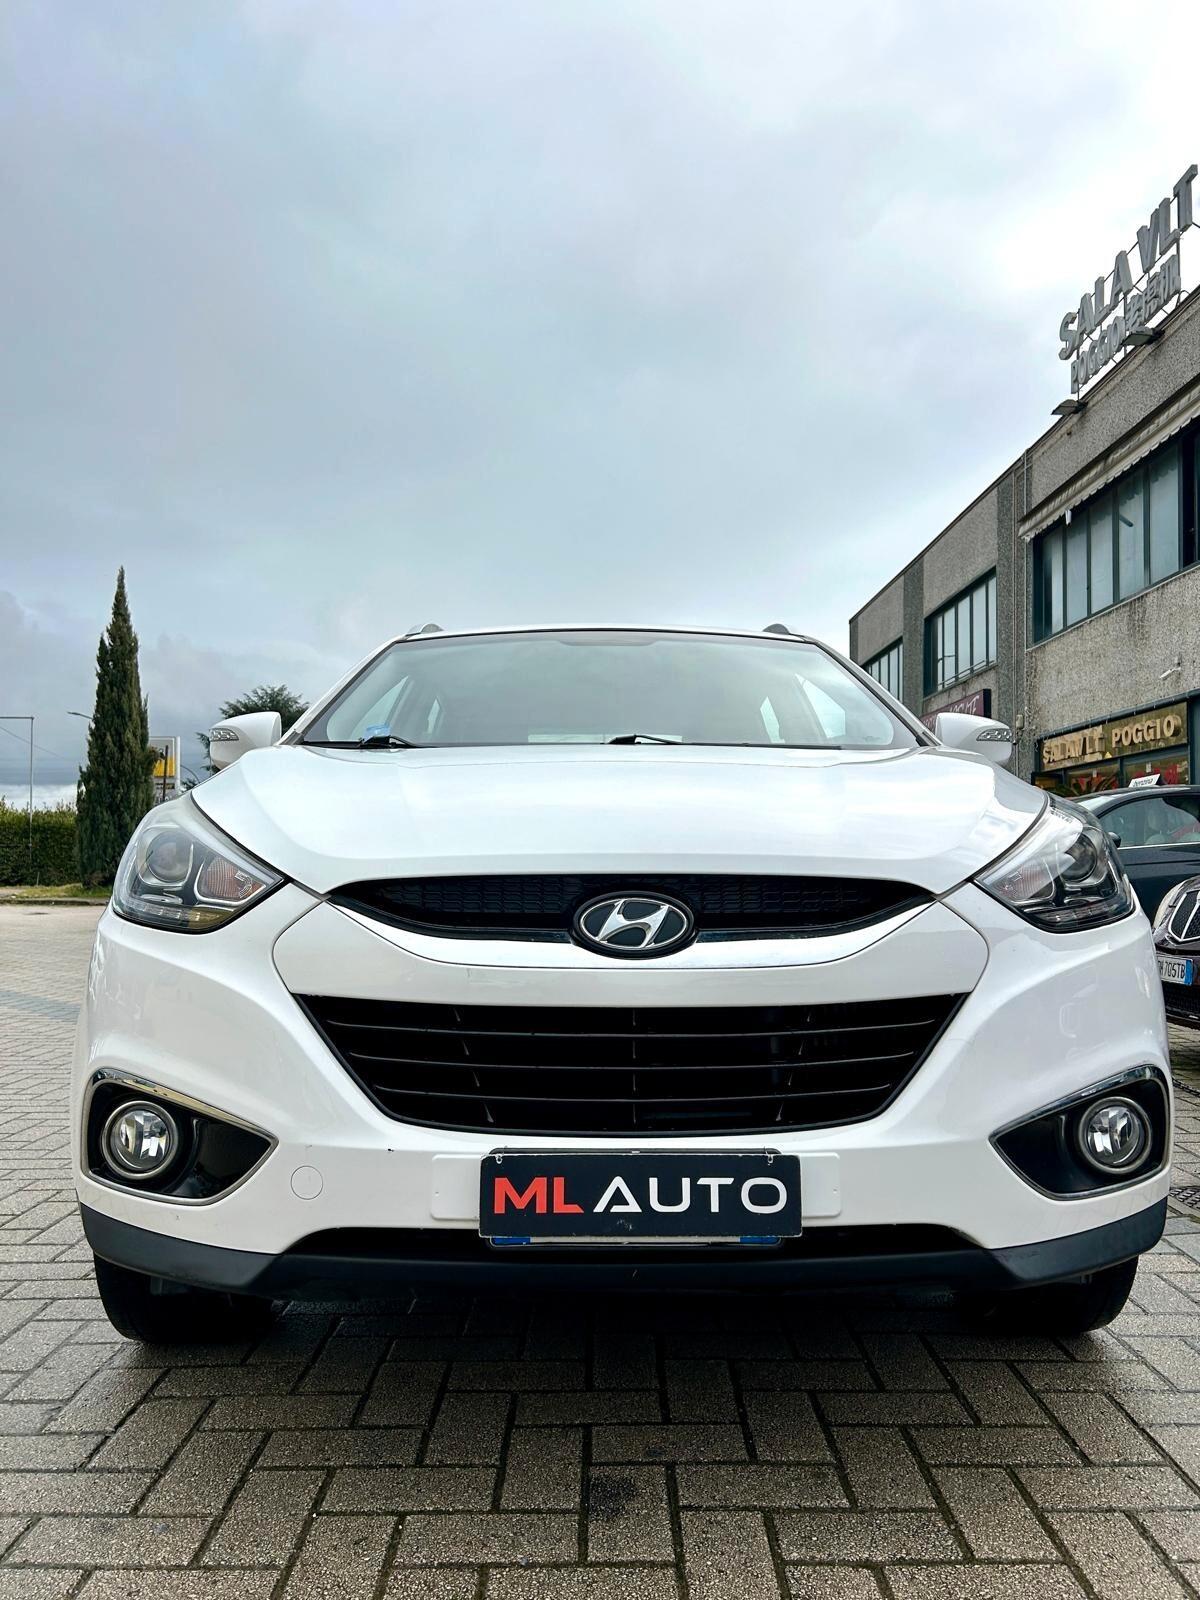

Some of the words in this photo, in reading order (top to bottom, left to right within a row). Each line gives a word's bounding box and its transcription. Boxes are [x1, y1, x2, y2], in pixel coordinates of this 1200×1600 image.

[1059, 250, 1133, 360] SALA
[1137, 164, 1198, 273] VLT
[1071, 316, 1125, 394] POGGIO
[1112, 715, 1180, 749] POGGIO
[494, 1177, 584, 1214] ML
[593, 1176, 787, 1214] AUTO
